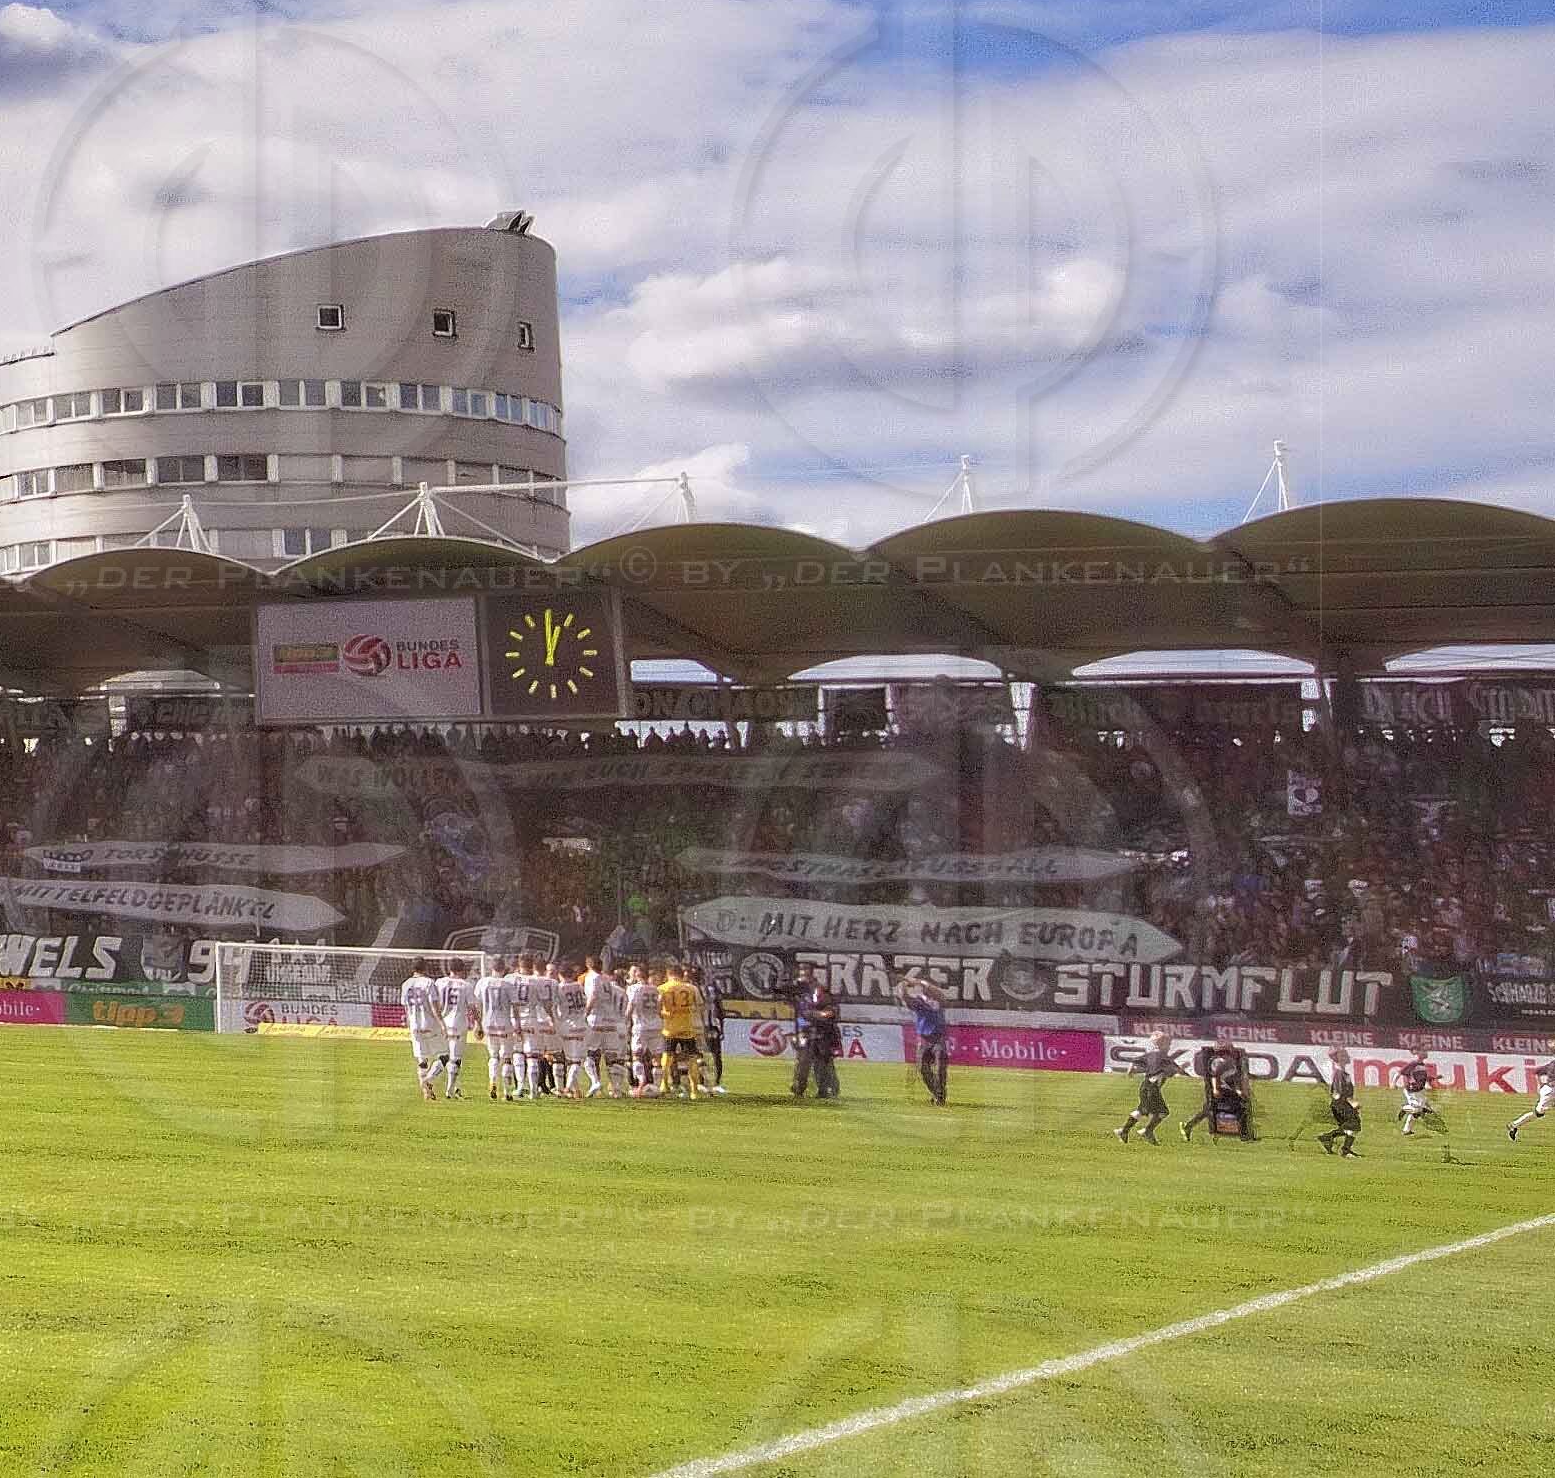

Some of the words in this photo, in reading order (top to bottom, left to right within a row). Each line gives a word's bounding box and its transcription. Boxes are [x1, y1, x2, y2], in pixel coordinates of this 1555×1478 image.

[396, 640, 460, 653] BUNDES
[396, 653, 463, 670] LIGA
[760, 912, 817, 937] MIT
[823, 916, 900, 943] HERZ
[920, 922, 1003, 946] NACH
[1020, 923, 1137, 957] EUROPA
[1053, 961, 1394, 1017] STURMFLUT
[280, 1003, 339, 1016] BUNDES
[1133, 1022, 1194, 1039] KLEINE
[1216, 1024, 1280, 1043] KLEINE
[1311, 1029, 1374, 1047] KLEINE
[1398, 1032, 1464, 1051] KLEINE
